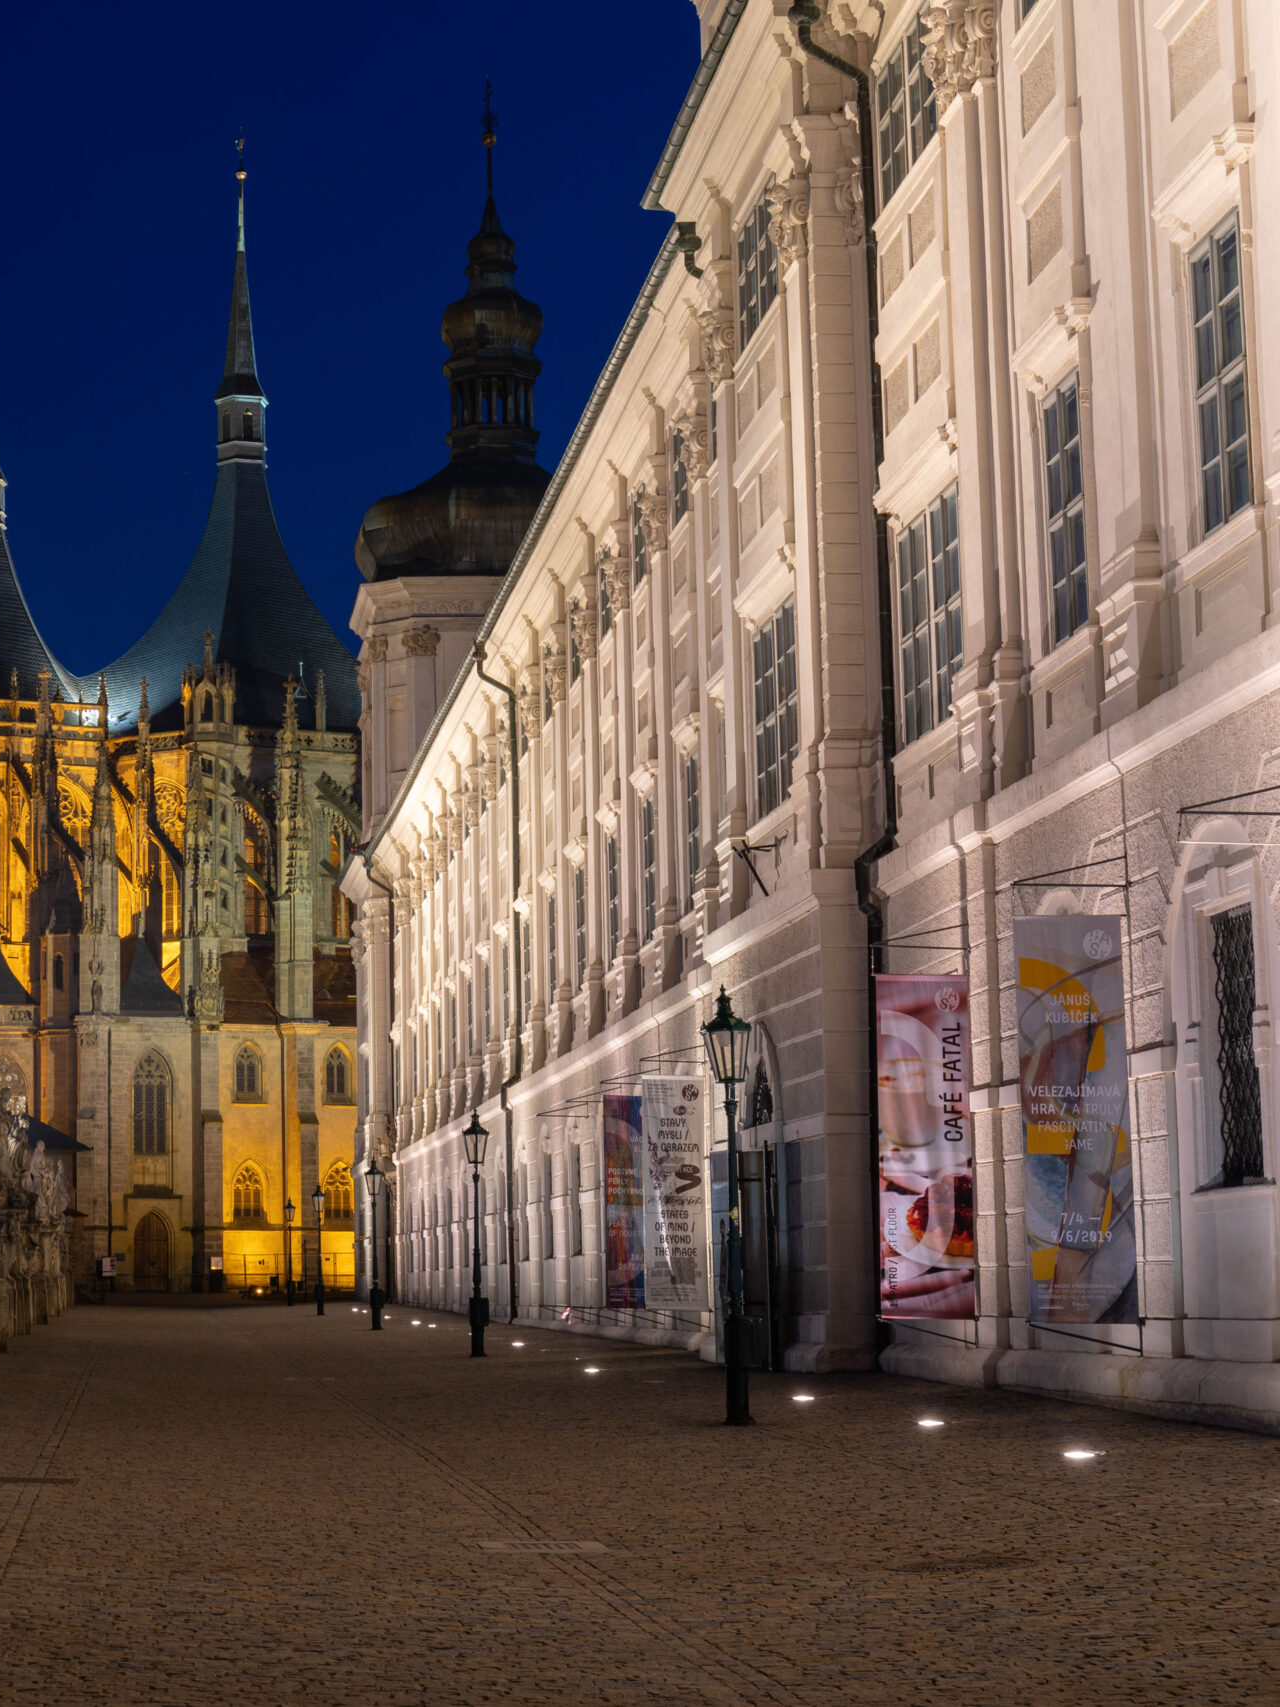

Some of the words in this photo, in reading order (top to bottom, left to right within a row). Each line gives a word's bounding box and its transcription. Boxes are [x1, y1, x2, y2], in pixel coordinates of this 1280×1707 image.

[1050, 992, 1090, 1006] JÁNUŠ
[1045, 1009, 1098, 1023] KUBÍČEK
[942, 1022, 962, 1082] FATAL
[1029, 1084, 1120, 1097] VELEZAJÍMAVÁ
[1031, 1103, 1055, 1115] HRA
[1060, 1102, 1067, 1116] /
[1072, 1104, 1080, 1114] A
[1085, 1103, 1121, 1115] TRULY
[660, 1118, 686, 1127] STAVY
[939, 1092, 963, 1142] CAFÉ
[658, 1130, 682, 1140] MYSLI
[684, 1130, 689, 1141] /
[661, 1143, 700, 1152] OBRAZEM
[661, 1210, 689, 1219] STATES
[1061, 1211, 1083, 1225] 7/4
[668, 1222, 688, 1232] MIND
[888, 1208, 898, 1236] FLOOR
[660, 1235, 691, 1244] BEYOND
[1050, 1230, 1112, 1243] 9/6/2019
[654, 1247, 669, 1256] THE
[672, 1247, 697, 1257] IMAGE
[888, 1267, 898, 1296] PATRO
